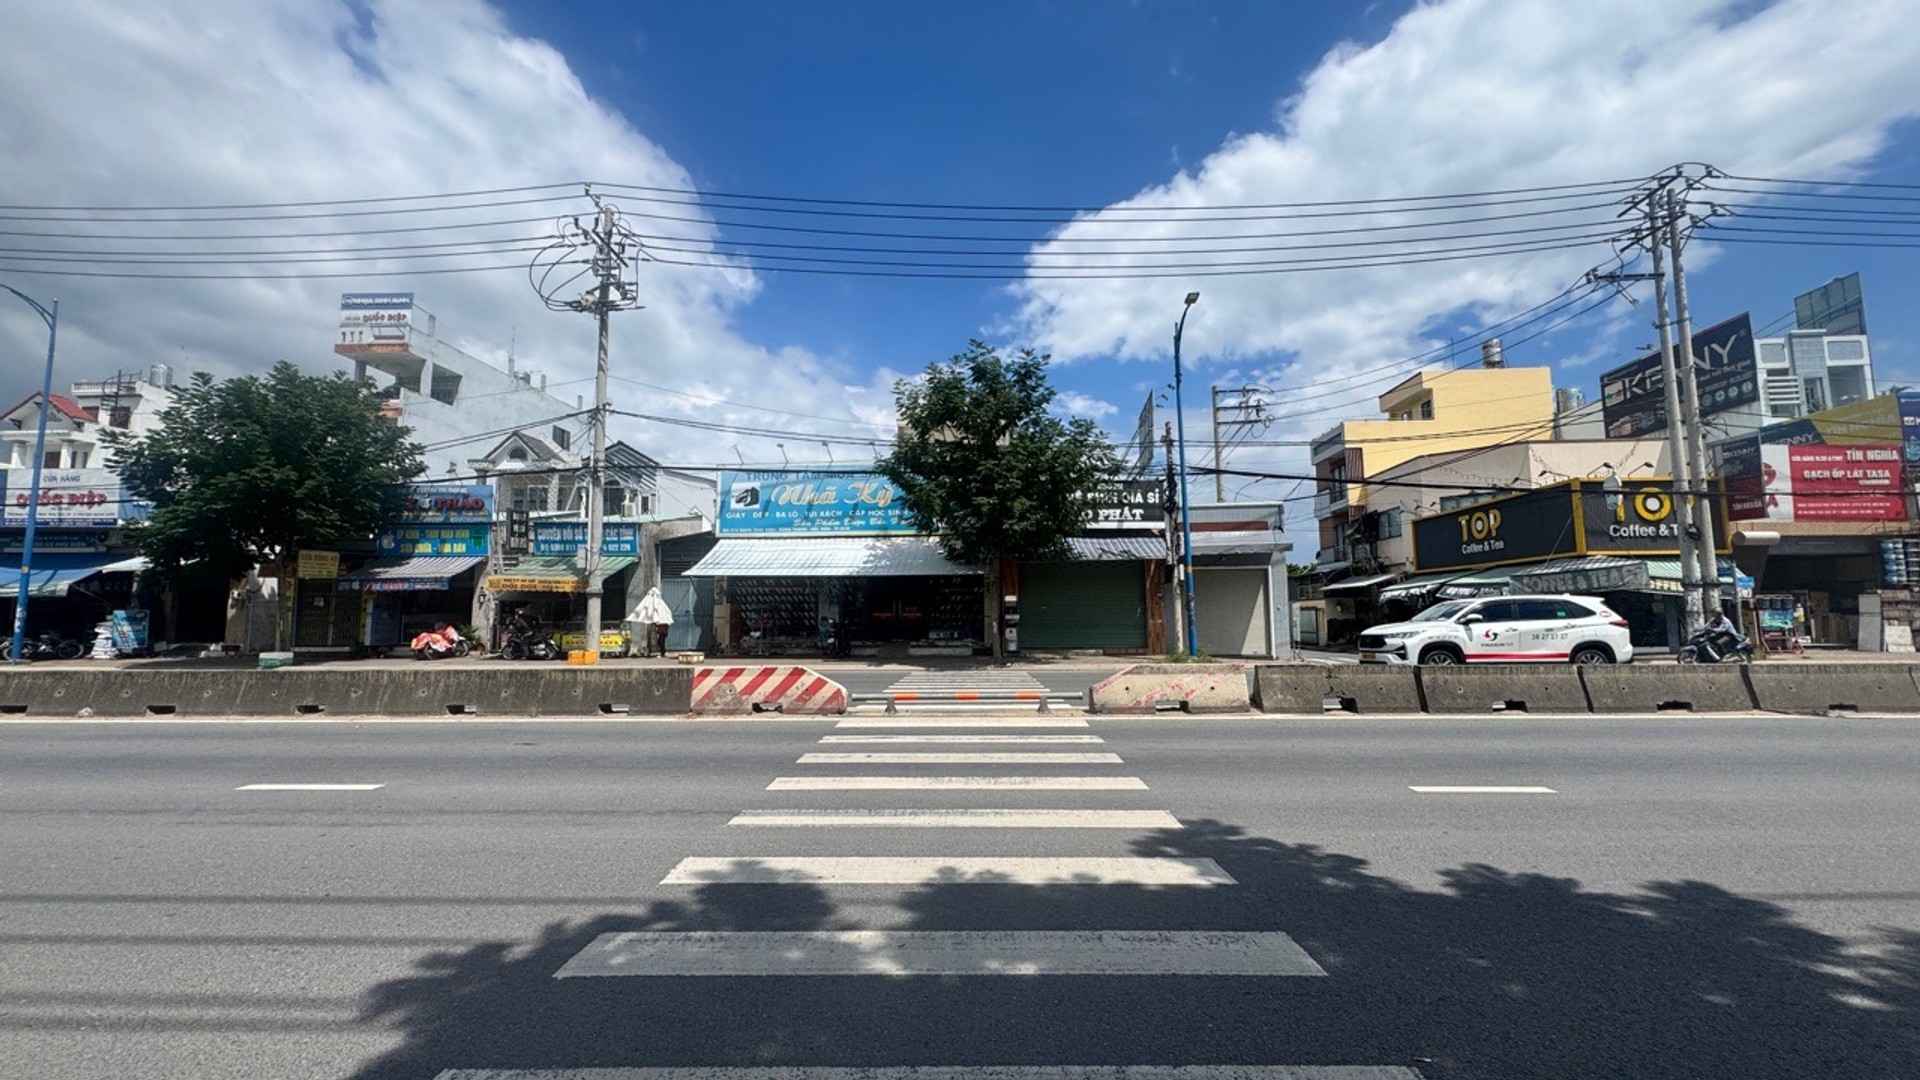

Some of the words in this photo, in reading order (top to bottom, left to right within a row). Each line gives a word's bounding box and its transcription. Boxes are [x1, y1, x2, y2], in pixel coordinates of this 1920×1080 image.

[1624, 334, 1738, 399] KENY
[1457, 508, 1502, 542] TOP
[1609, 525, 1657, 537] Coffee
[1658, 523, 1670, 536] &
